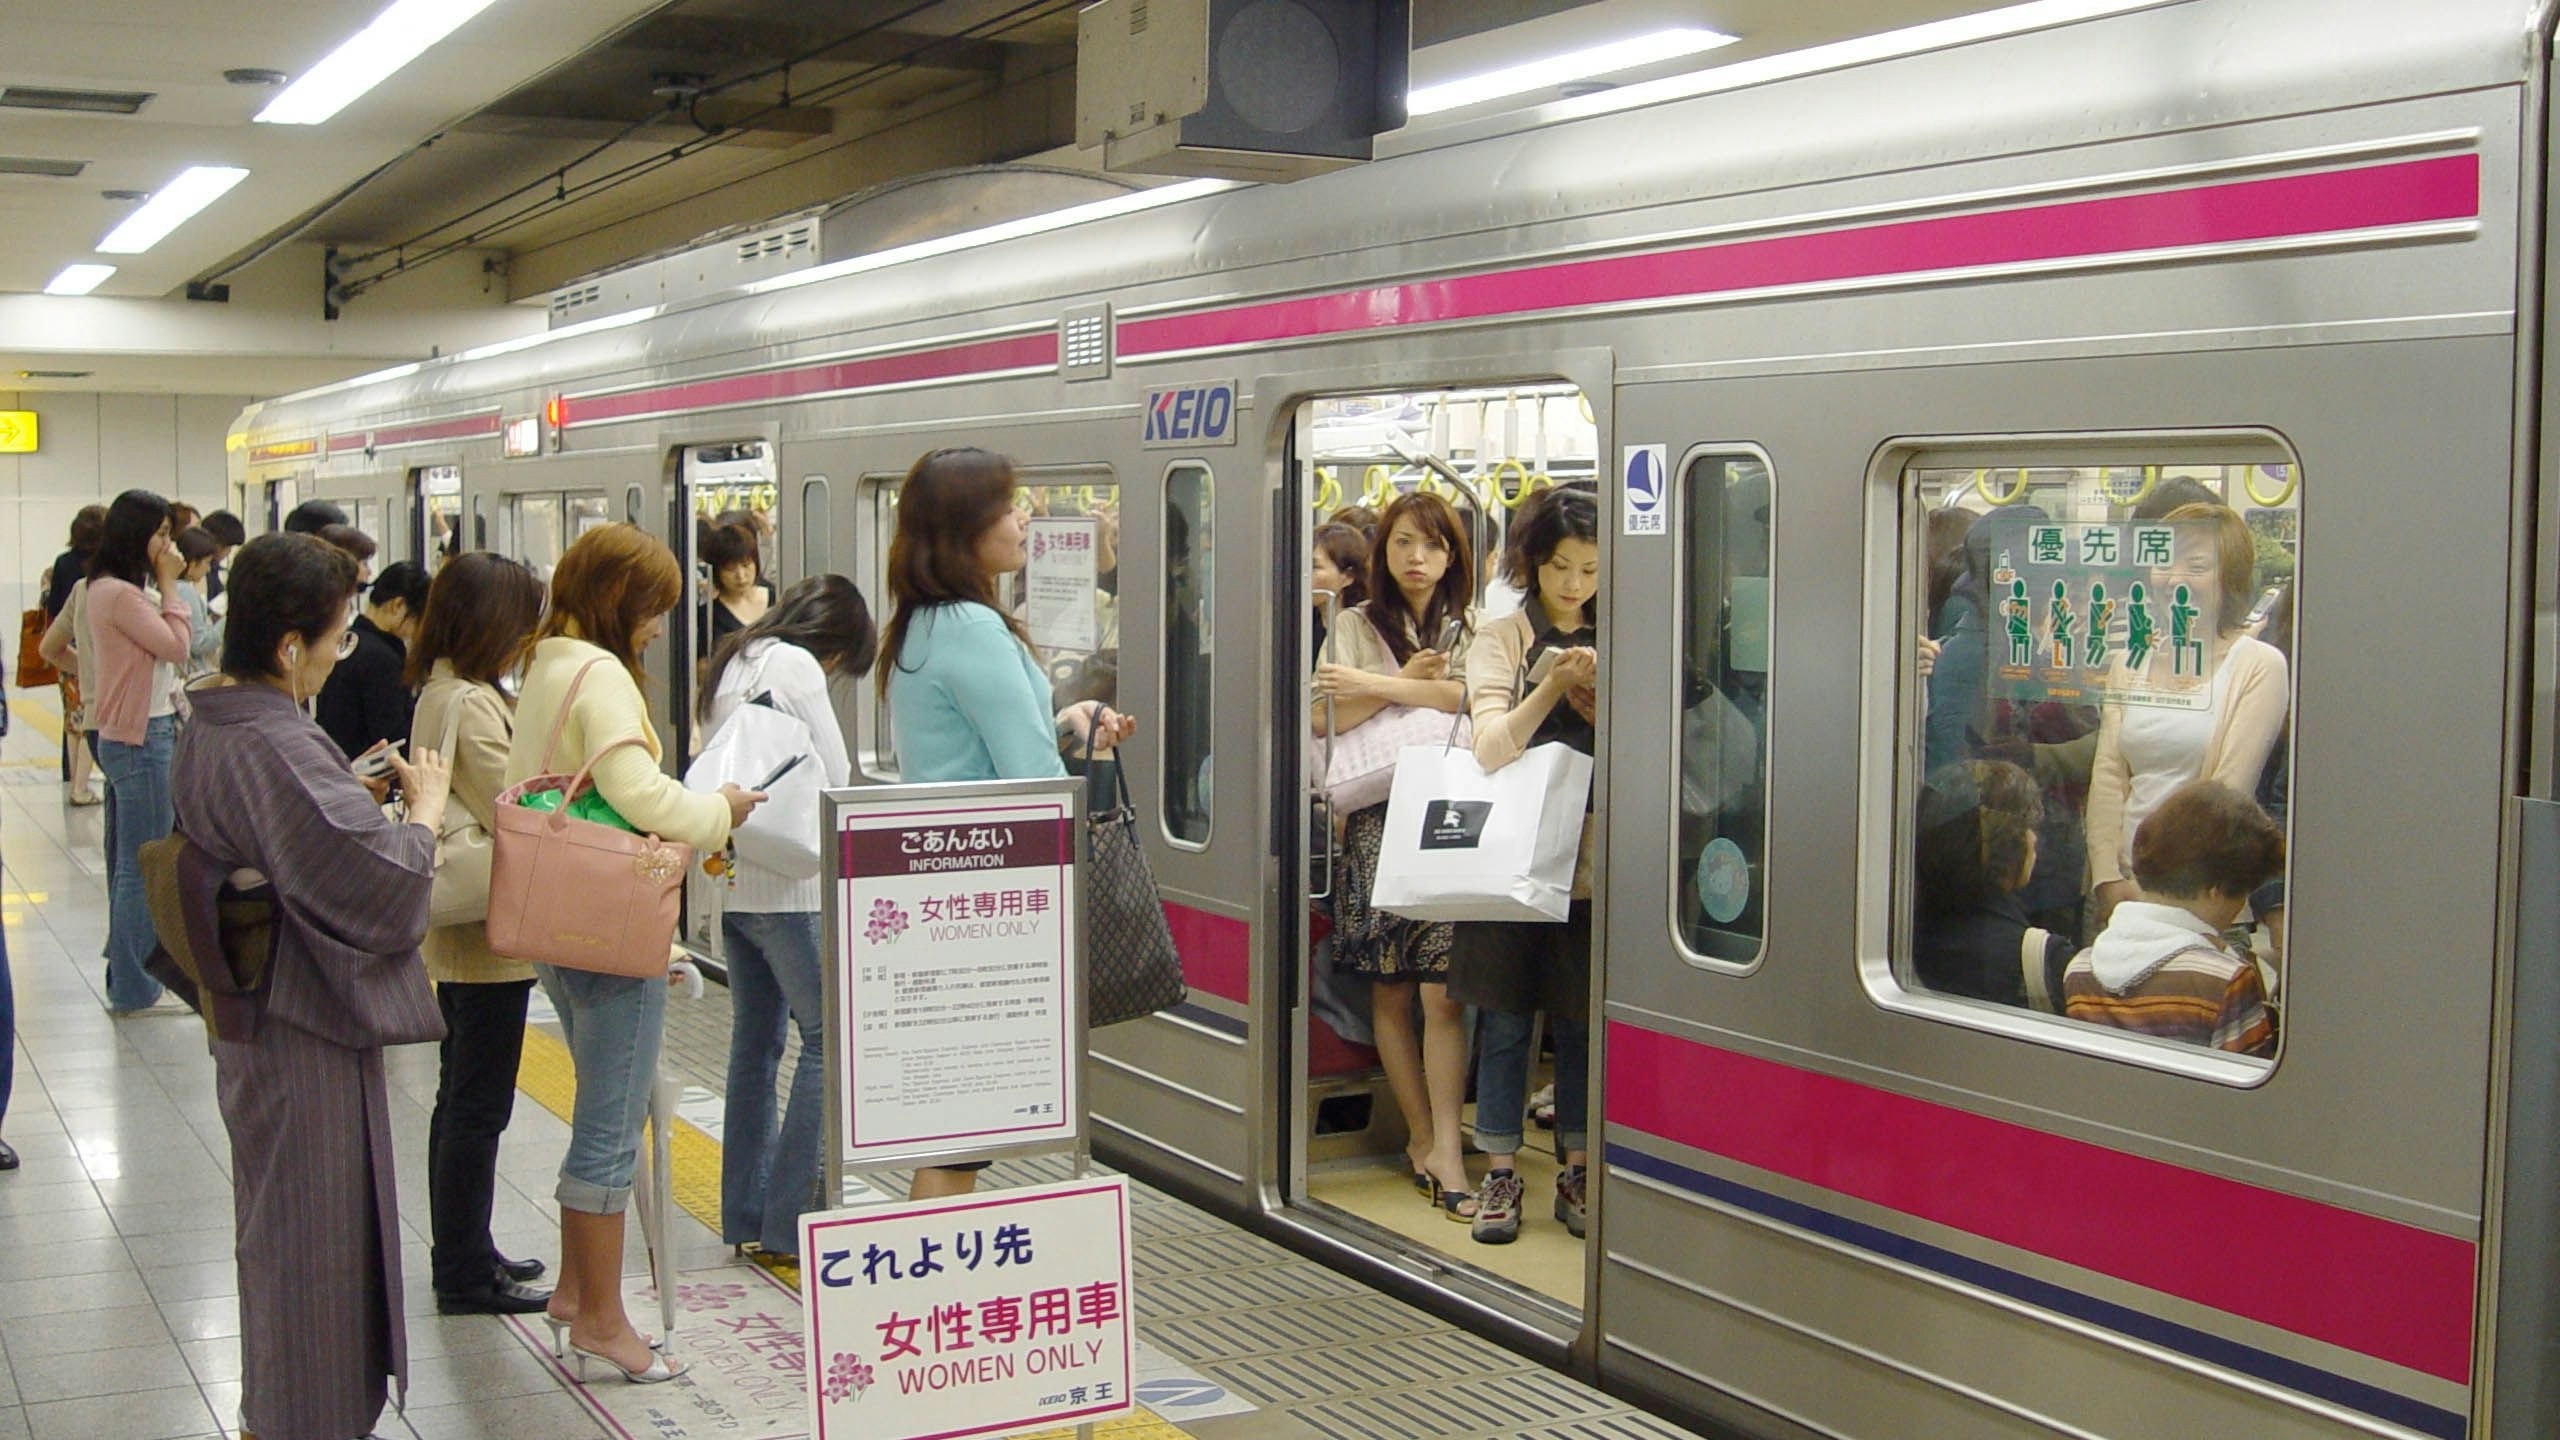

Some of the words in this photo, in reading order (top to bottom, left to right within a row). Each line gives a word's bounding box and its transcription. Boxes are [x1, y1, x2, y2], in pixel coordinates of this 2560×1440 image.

[1145, 387, 1231, 441] KEIO
[2031, 527, 2173, 566] 優先席
[900, 827, 1014, 854] ごあんない
[909, 854, 1004, 872] INFORMATION
[919, 888, 1050, 923] 女性専用車
[930, 922, 993, 942] WOMEN
[998, 919, 1040, 937] ONLY
[820, 1223, 1034, 1289] これより先
[875, 1280, 1121, 1363] 女性専用車
[898, 1352, 1015, 1395] WOMEN
[1027, 1338, 1104, 1375] ONLY
[1069, 1382, 1114, 1405] 京王
